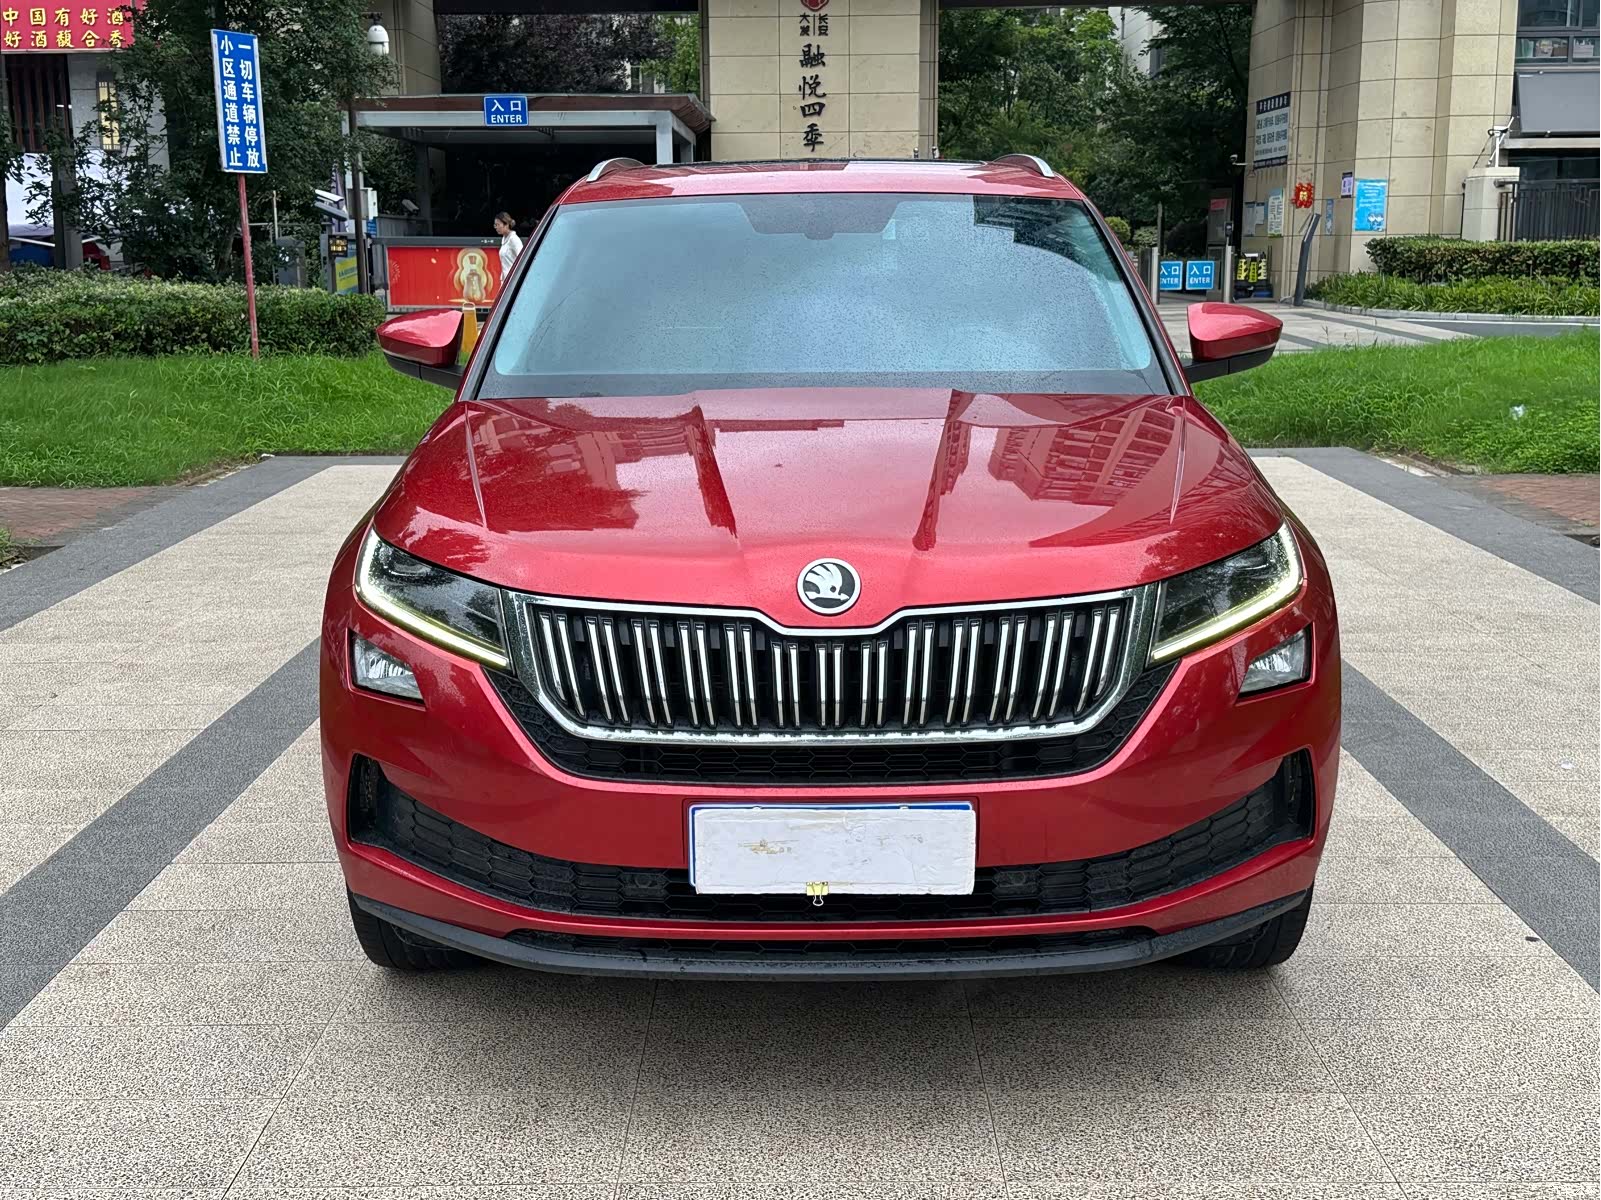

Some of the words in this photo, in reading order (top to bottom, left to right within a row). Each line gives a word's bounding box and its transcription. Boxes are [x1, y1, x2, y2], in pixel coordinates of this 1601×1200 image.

[2, 7, 124, 27] 中国有好酒
[3, 29, 126, 48] 好酒馥合香
[220, 34, 243, 167] 小区通道禁止
[237, 43, 260, 168] 一切车辆停放
[491, 99, 522, 112] 入口
[799, 43, 826, 152] 融悦四季
[491, 114, 523, 124] ENTER
[1190, 265, 1210, 275] 入口
